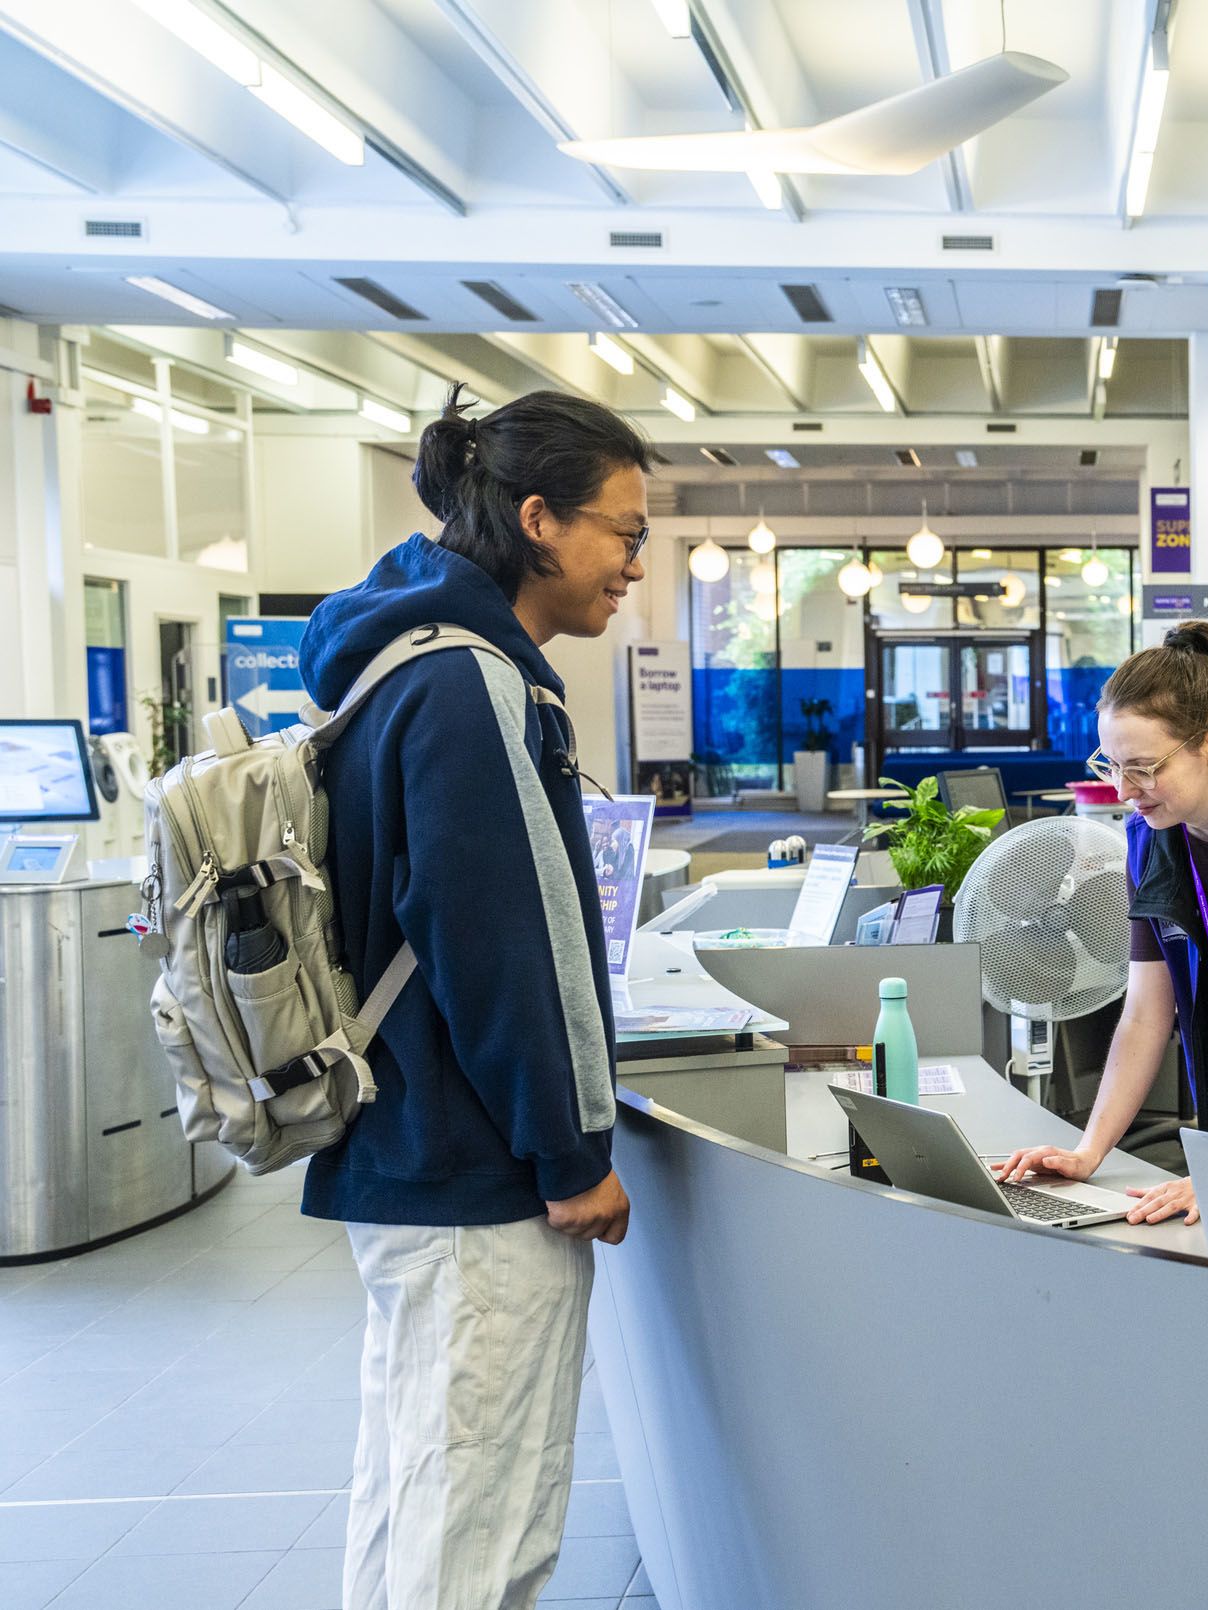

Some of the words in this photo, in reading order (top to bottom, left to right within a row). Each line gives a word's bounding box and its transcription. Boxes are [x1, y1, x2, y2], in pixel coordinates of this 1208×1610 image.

[1156, 533, 1191, 547] ZON
[234, 652, 300, 669] collect
[640, 668, 677, 678] Borrow
[649, 681, 681, 692] laptop
[597, 885, 619, 898] NITY
